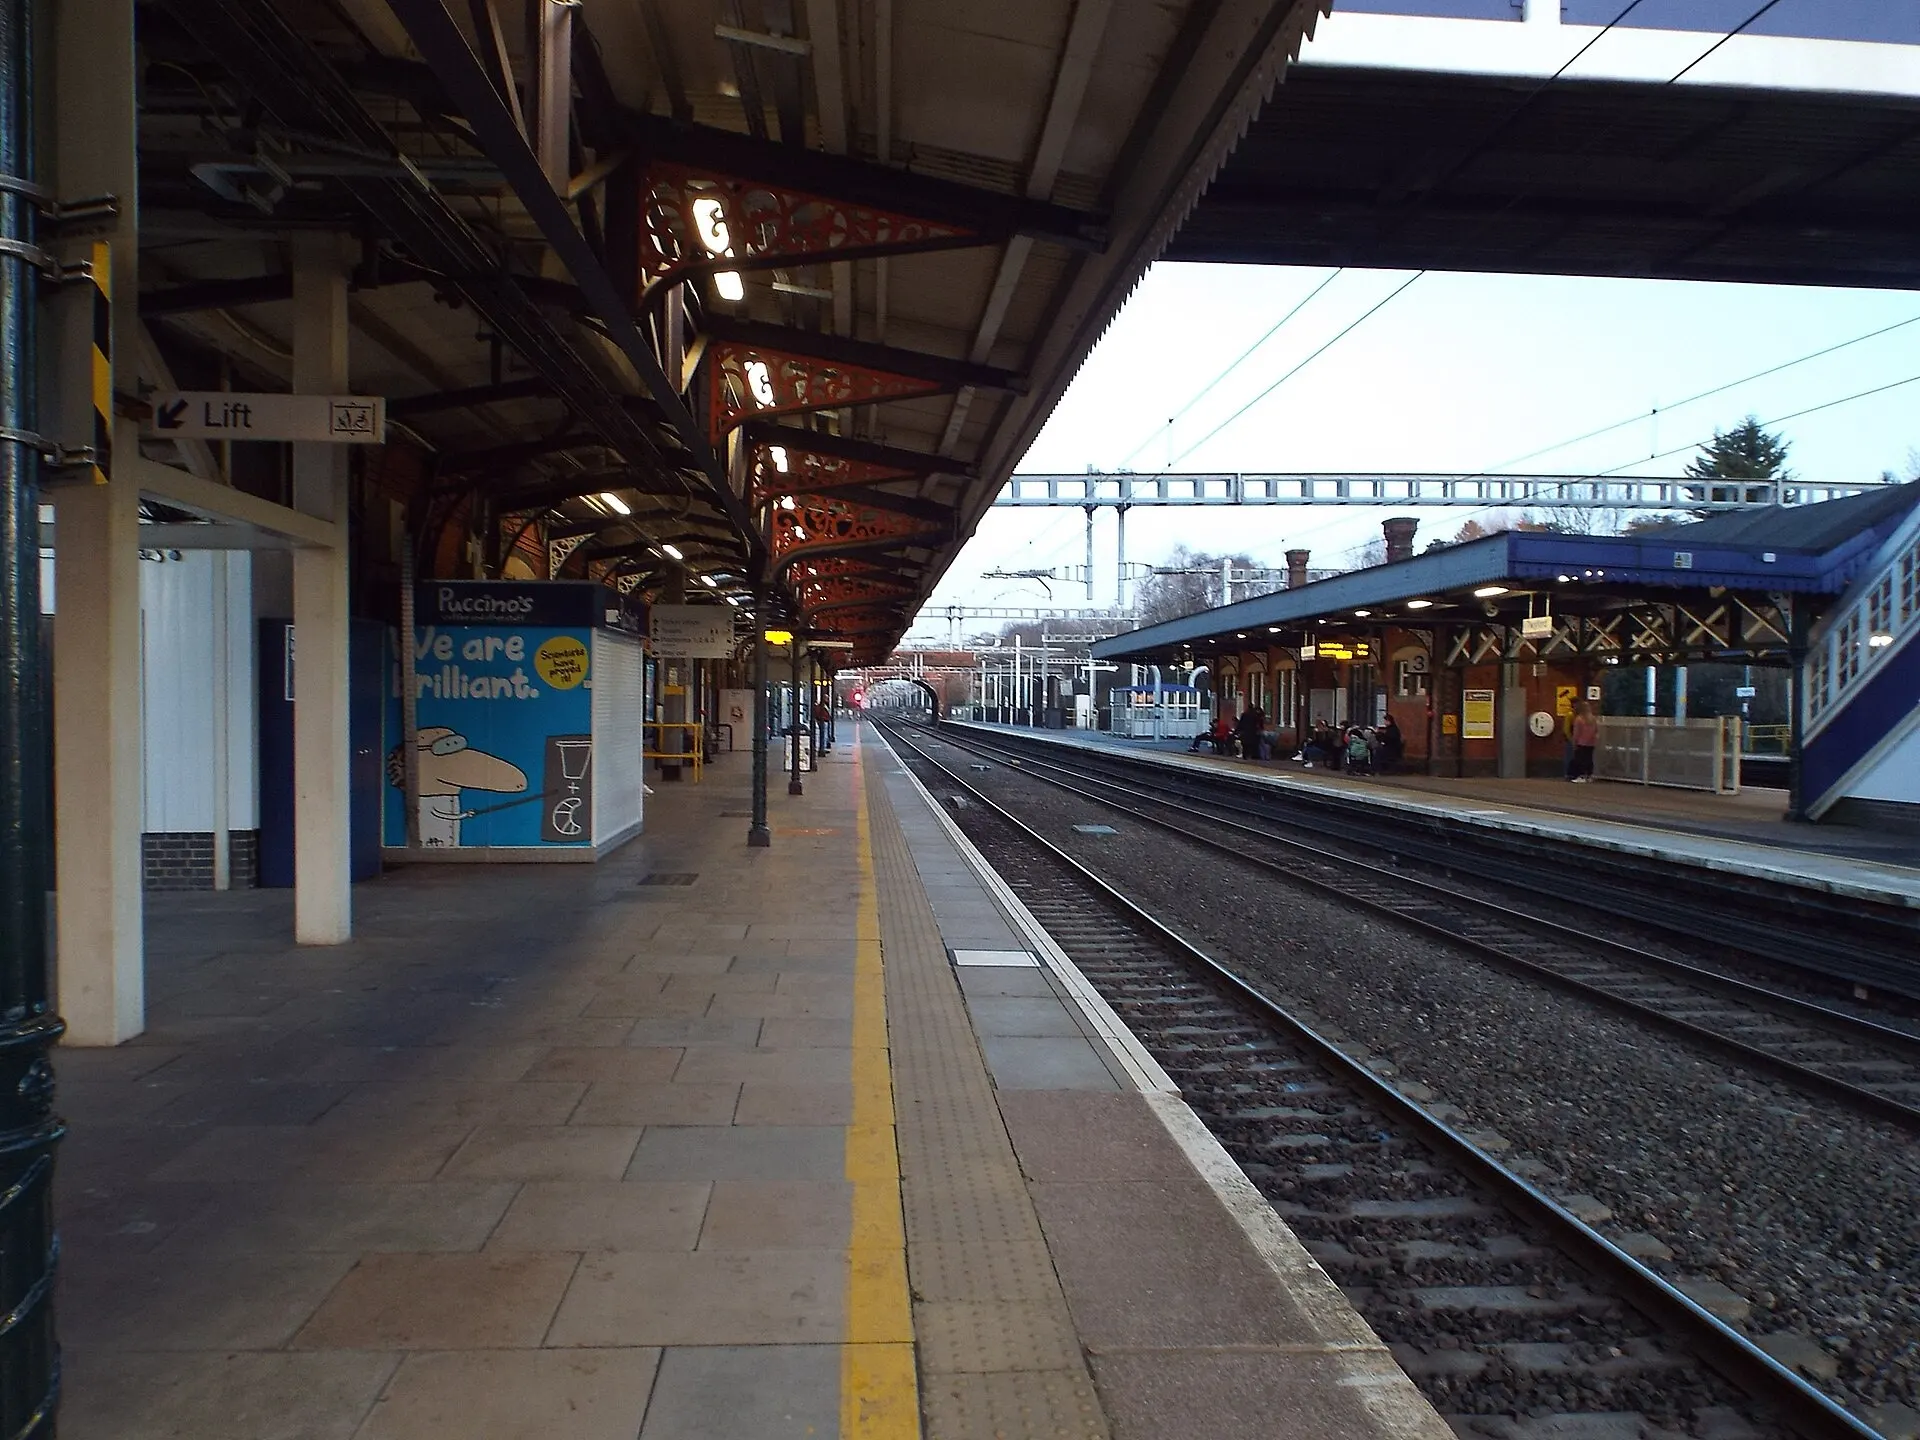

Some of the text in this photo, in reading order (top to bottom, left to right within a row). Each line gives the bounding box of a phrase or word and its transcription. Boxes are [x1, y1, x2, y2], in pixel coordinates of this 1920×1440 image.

[203, 401, 252, 428] Lift
[438, 586, 534, 613] Puccino's
[462, 635, 525, 662] are
[1413, 655, 1425, 671] 3
